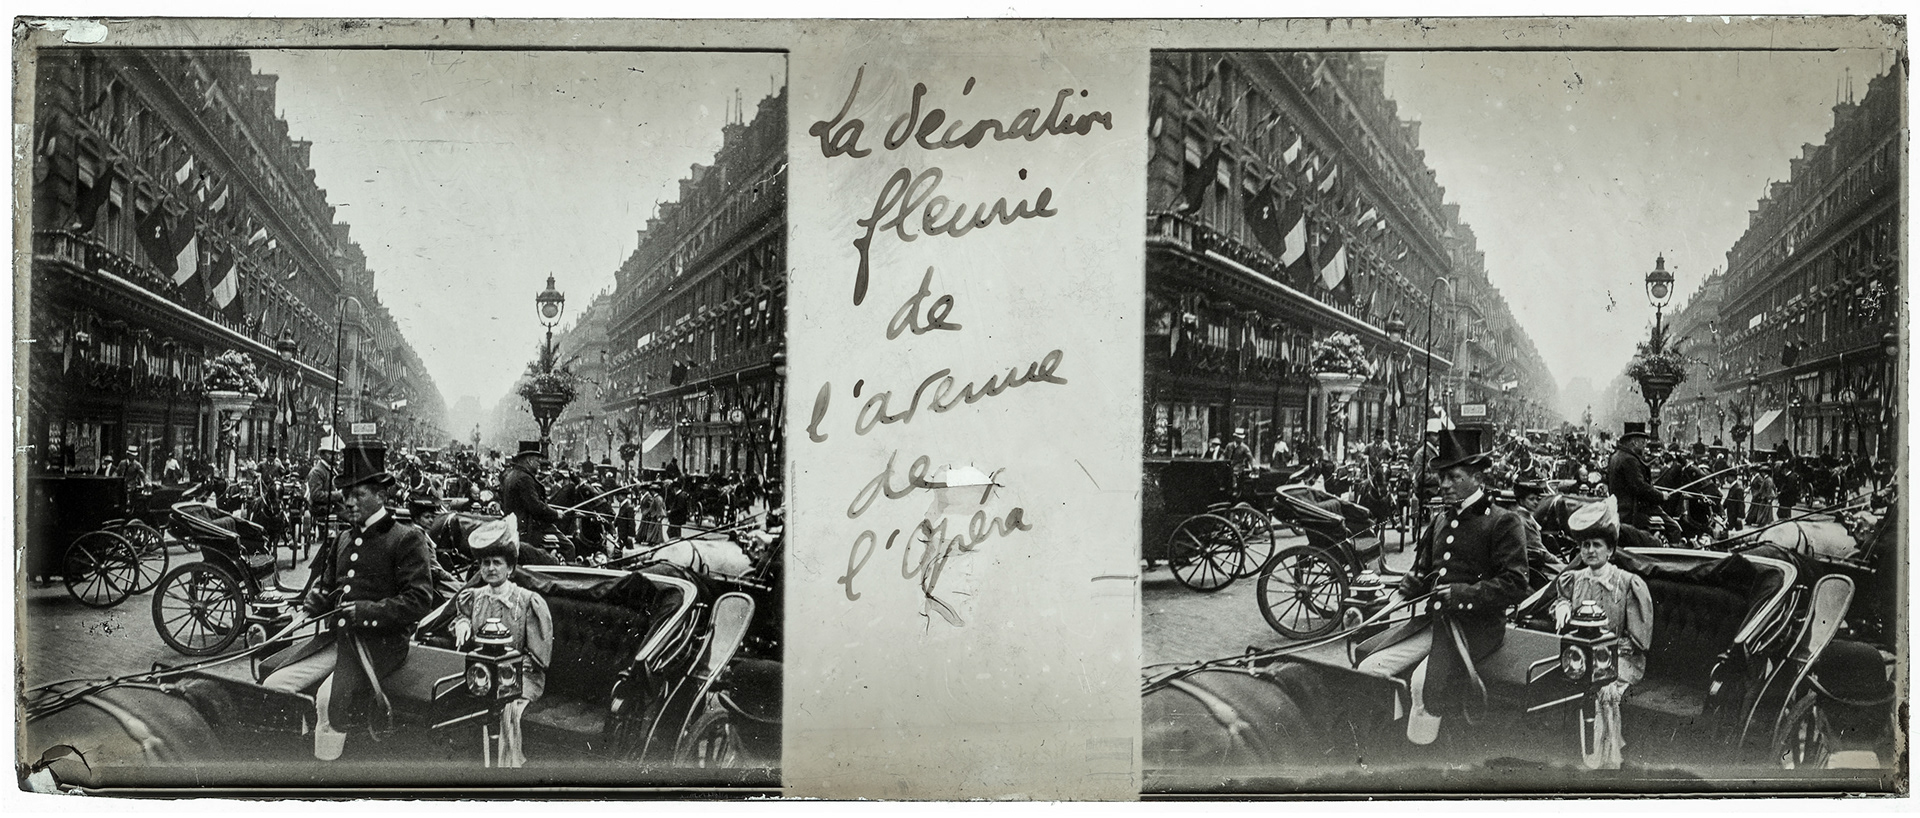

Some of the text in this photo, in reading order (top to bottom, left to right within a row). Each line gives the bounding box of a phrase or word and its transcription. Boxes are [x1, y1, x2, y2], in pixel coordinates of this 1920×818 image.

[809, 63, 1113, 158] La décoration
[853, 167, 1058, 306] fleurie
[886, 266, 962, 340] de
[806, 349, 1068, 443] l'avenue
[847, 449, 948, 519] de
